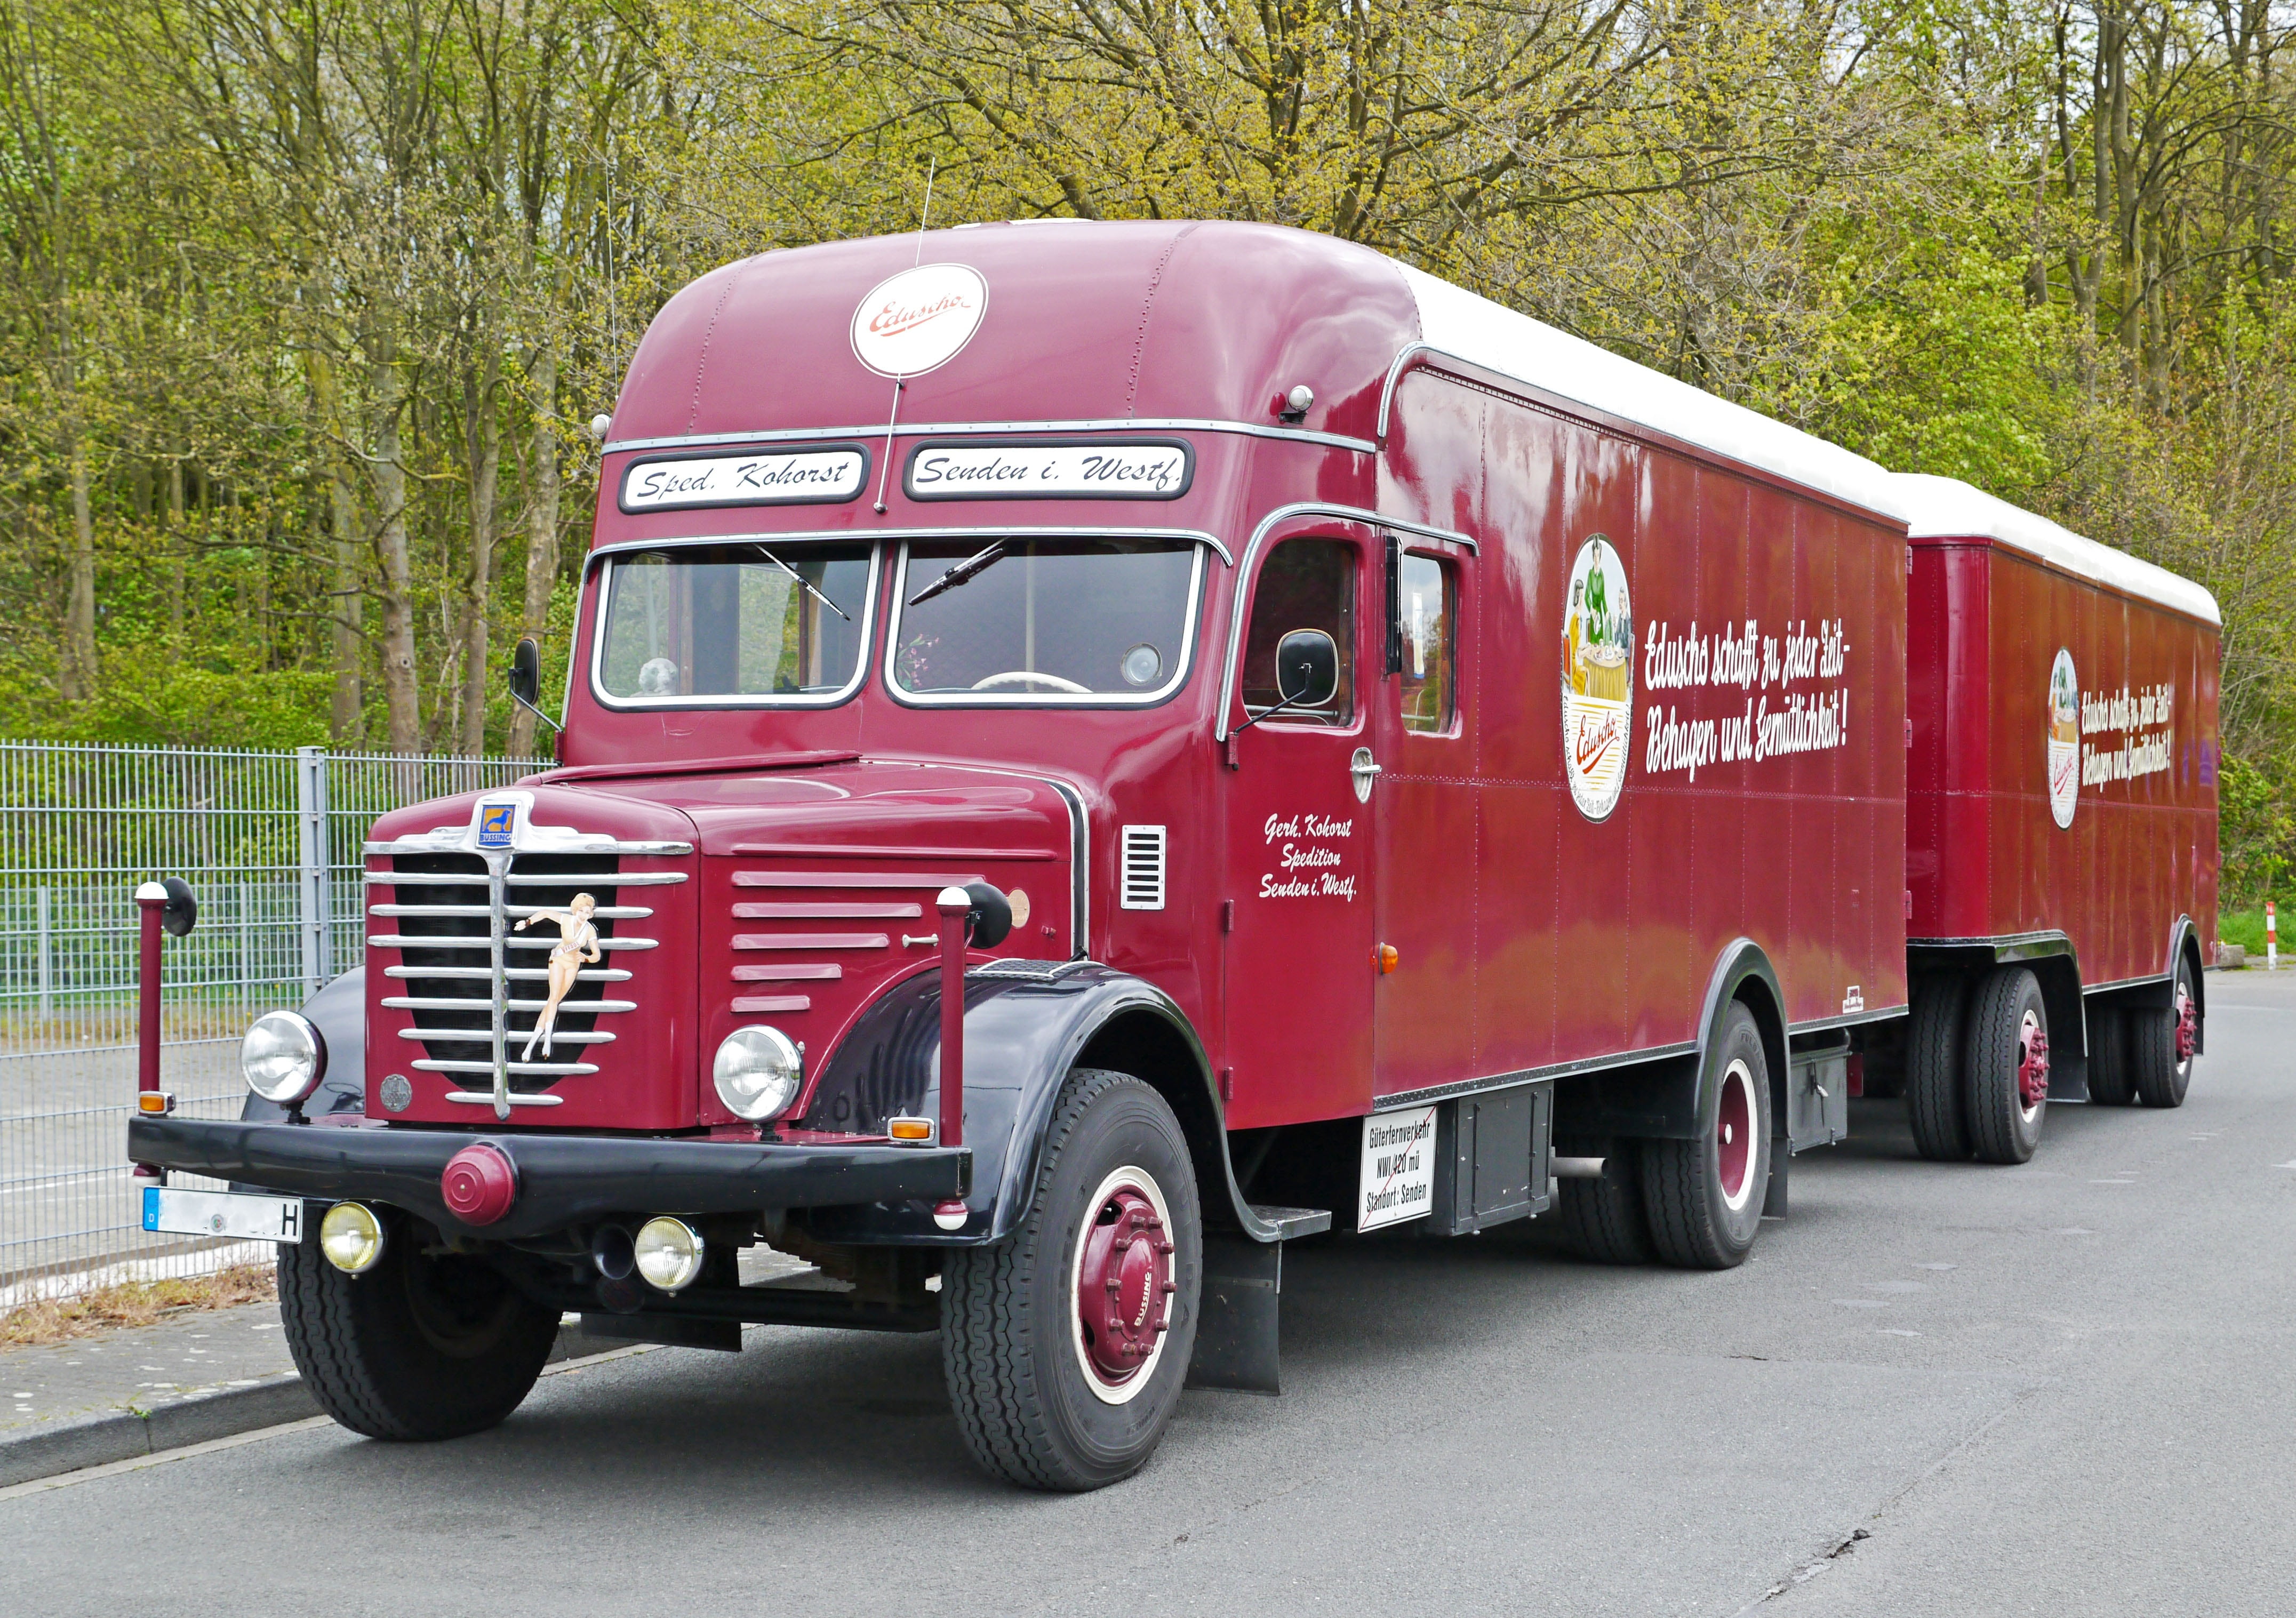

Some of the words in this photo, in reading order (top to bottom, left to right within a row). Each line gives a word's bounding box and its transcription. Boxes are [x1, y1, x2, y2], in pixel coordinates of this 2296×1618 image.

[869, 293, 971, 337] Eduscho
[637, 471, 715, 499] Sped.
[737, 461, 849, 488] Kohorst
[915, 456, 1031, 485] Senden
[1041, 460, 1060, 483] i.
[1081, 453, 1182, 492] Westf.
[1645, 620, 1707, 691] Eduscho
[1711, 619, 1759, 690] schafft
[1761, 635, 1780, 691] zu
[1782, 621, 1818, 690] jeder
[1820, 618, 1850, 678] Zeit-
[1577, 710, 1619, 774] Eduscho
[1646, 704, 1718, 783] Behagen
[1721, 698, 1753, 762] und
[1755, 688, 1847, 763] Gemütlichkeit!
[1264, 813, 1301, 845] Gerh.
[1305, 814, 1353, 837] Kohorst
[1281, 843, 1341, 873] Spedition
[1259, 874, 1309, 898] Senden
[1311, 878, 1319, 896] i.
[1321, 872, 1357, 902] Westf.
[1370, 1119, 1430, 1149] Güterfernverkehr
[1409, 1150, 1420, 1172] mü
[1367, 1187, 1399, 1213] Standort:
[1401, 1181, 1426, 1205] Senden
[148, 1214, 155, 1222] D
[282, 1203, 298, 1236] H
